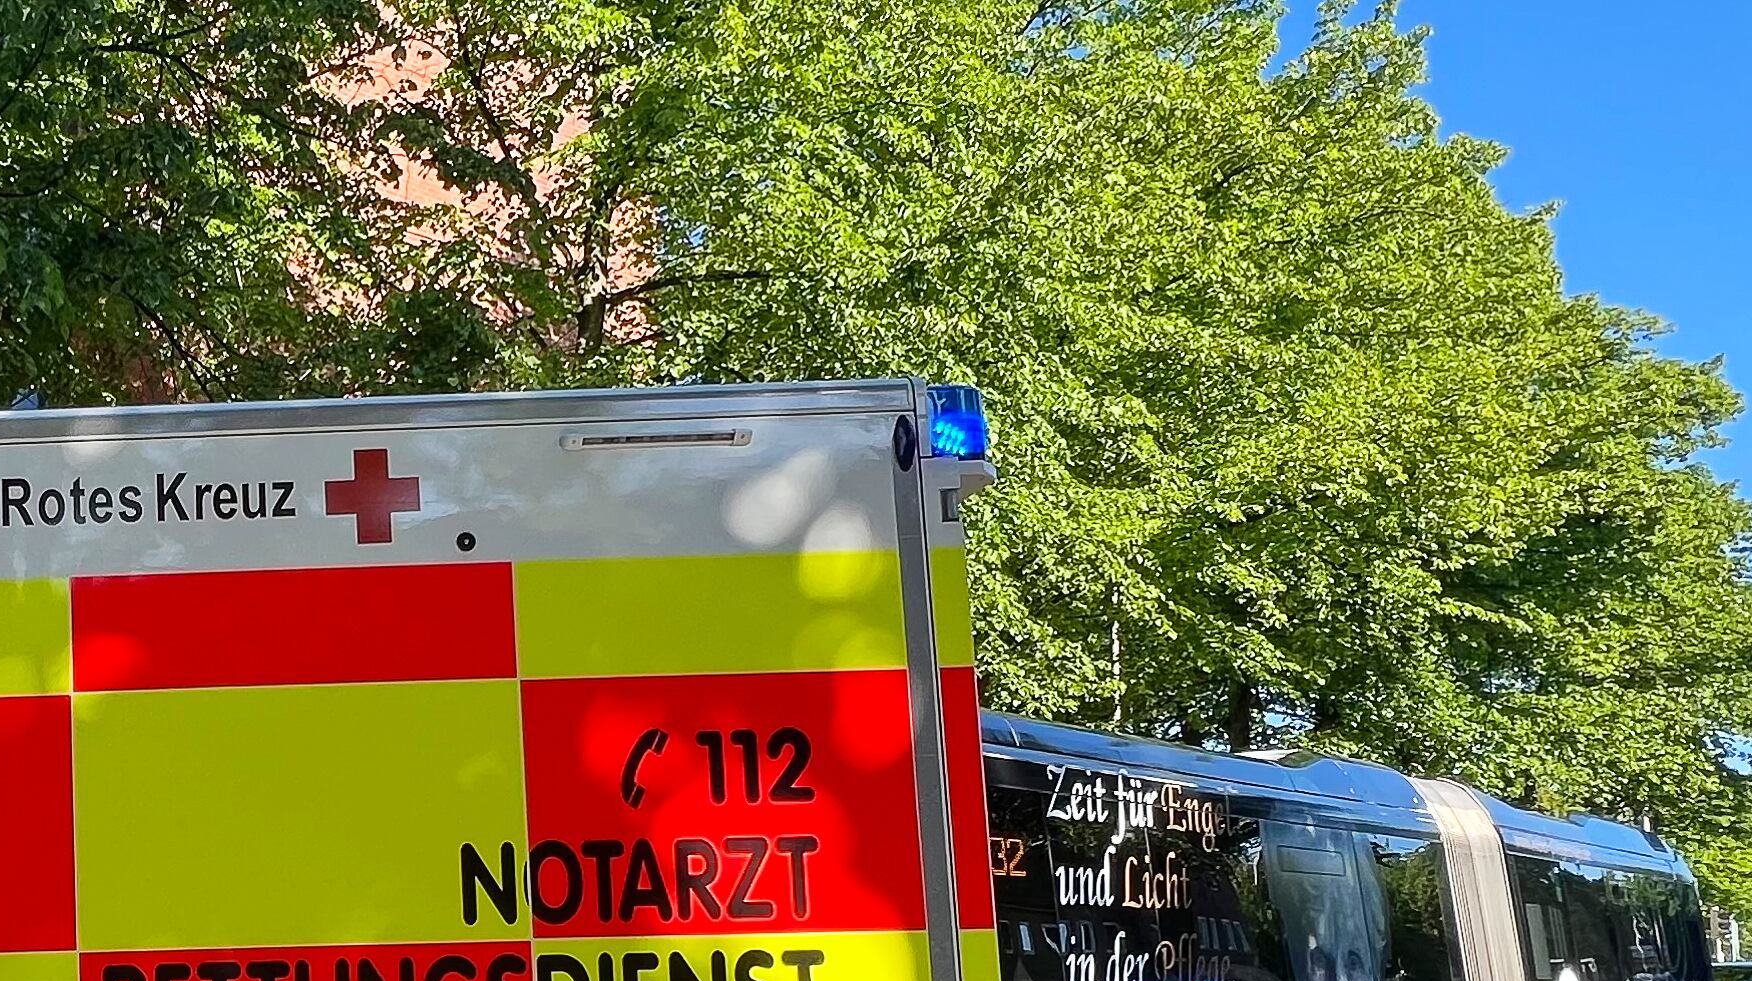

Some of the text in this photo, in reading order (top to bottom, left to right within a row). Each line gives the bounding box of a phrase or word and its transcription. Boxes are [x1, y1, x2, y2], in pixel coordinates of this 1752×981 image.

[1, 477, 143, 528] Rotes
[156, 472, 296, 524] Kreuz
[694, 728, 815, 804] 112
[1047, 765, 1109, 823] Zeit
[1111, 768, 1158, 845] für
[460, 835, 820, 926] NOTARZT
[1055, 846, 1192, 909] und Licht
